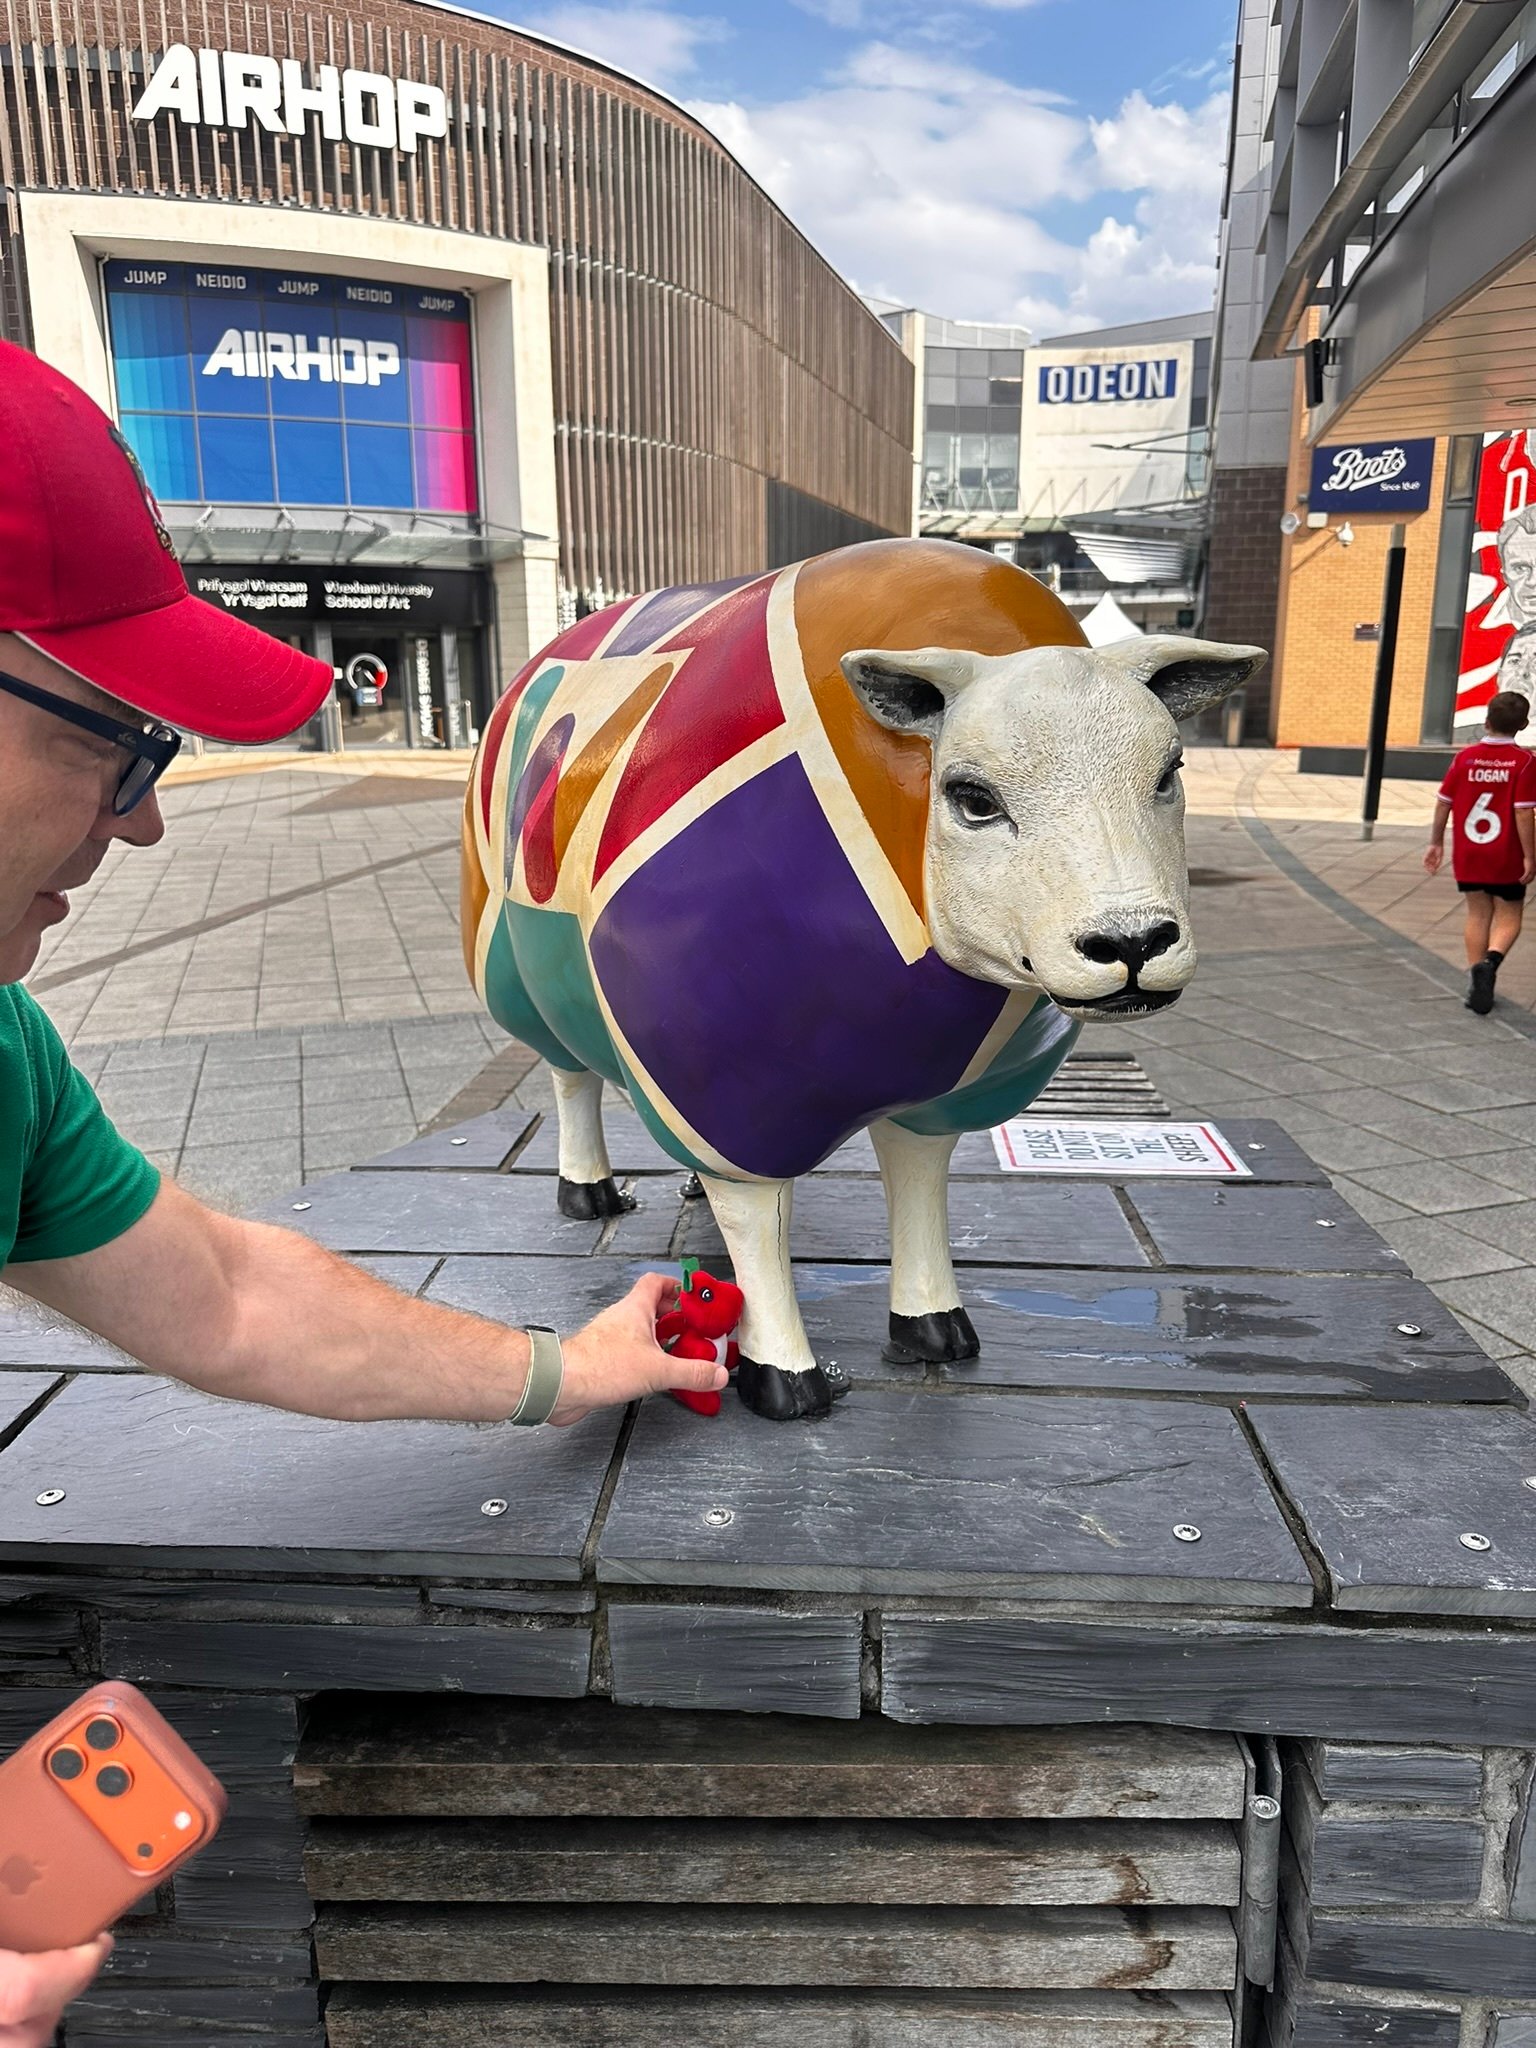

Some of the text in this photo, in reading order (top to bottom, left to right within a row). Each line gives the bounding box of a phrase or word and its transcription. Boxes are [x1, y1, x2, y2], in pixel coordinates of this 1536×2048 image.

[131, 43, 447, 154] AIRHOP
[124, 270, 455, 312] JUMP NEIDIO JUMP NEIDIO JUMP
[202, 328, 400, 386] AIRHOP
[1046, 360, 1168, 404] ODEON
[1322, 446, 1407, 492] Boots
[197, 577, 250, 594] Prifysgol
[323, 579, 434, 599] Wrexham University
[324, 593, 411, 610] School of Art
[1468, 768, 1510, 783] LOGAN
[1464, 792, 1501, 844] 6
[1023, 1129, 1062, 1160] PLEASE
[1057, 1129, 1099, 1160] DO NOT
[1092, 1132, 1134, 1160] SIT ON
[1130, 1138, 1168, 1154] THE
[1162, 1132, 1208, 1162] SHEEP!
